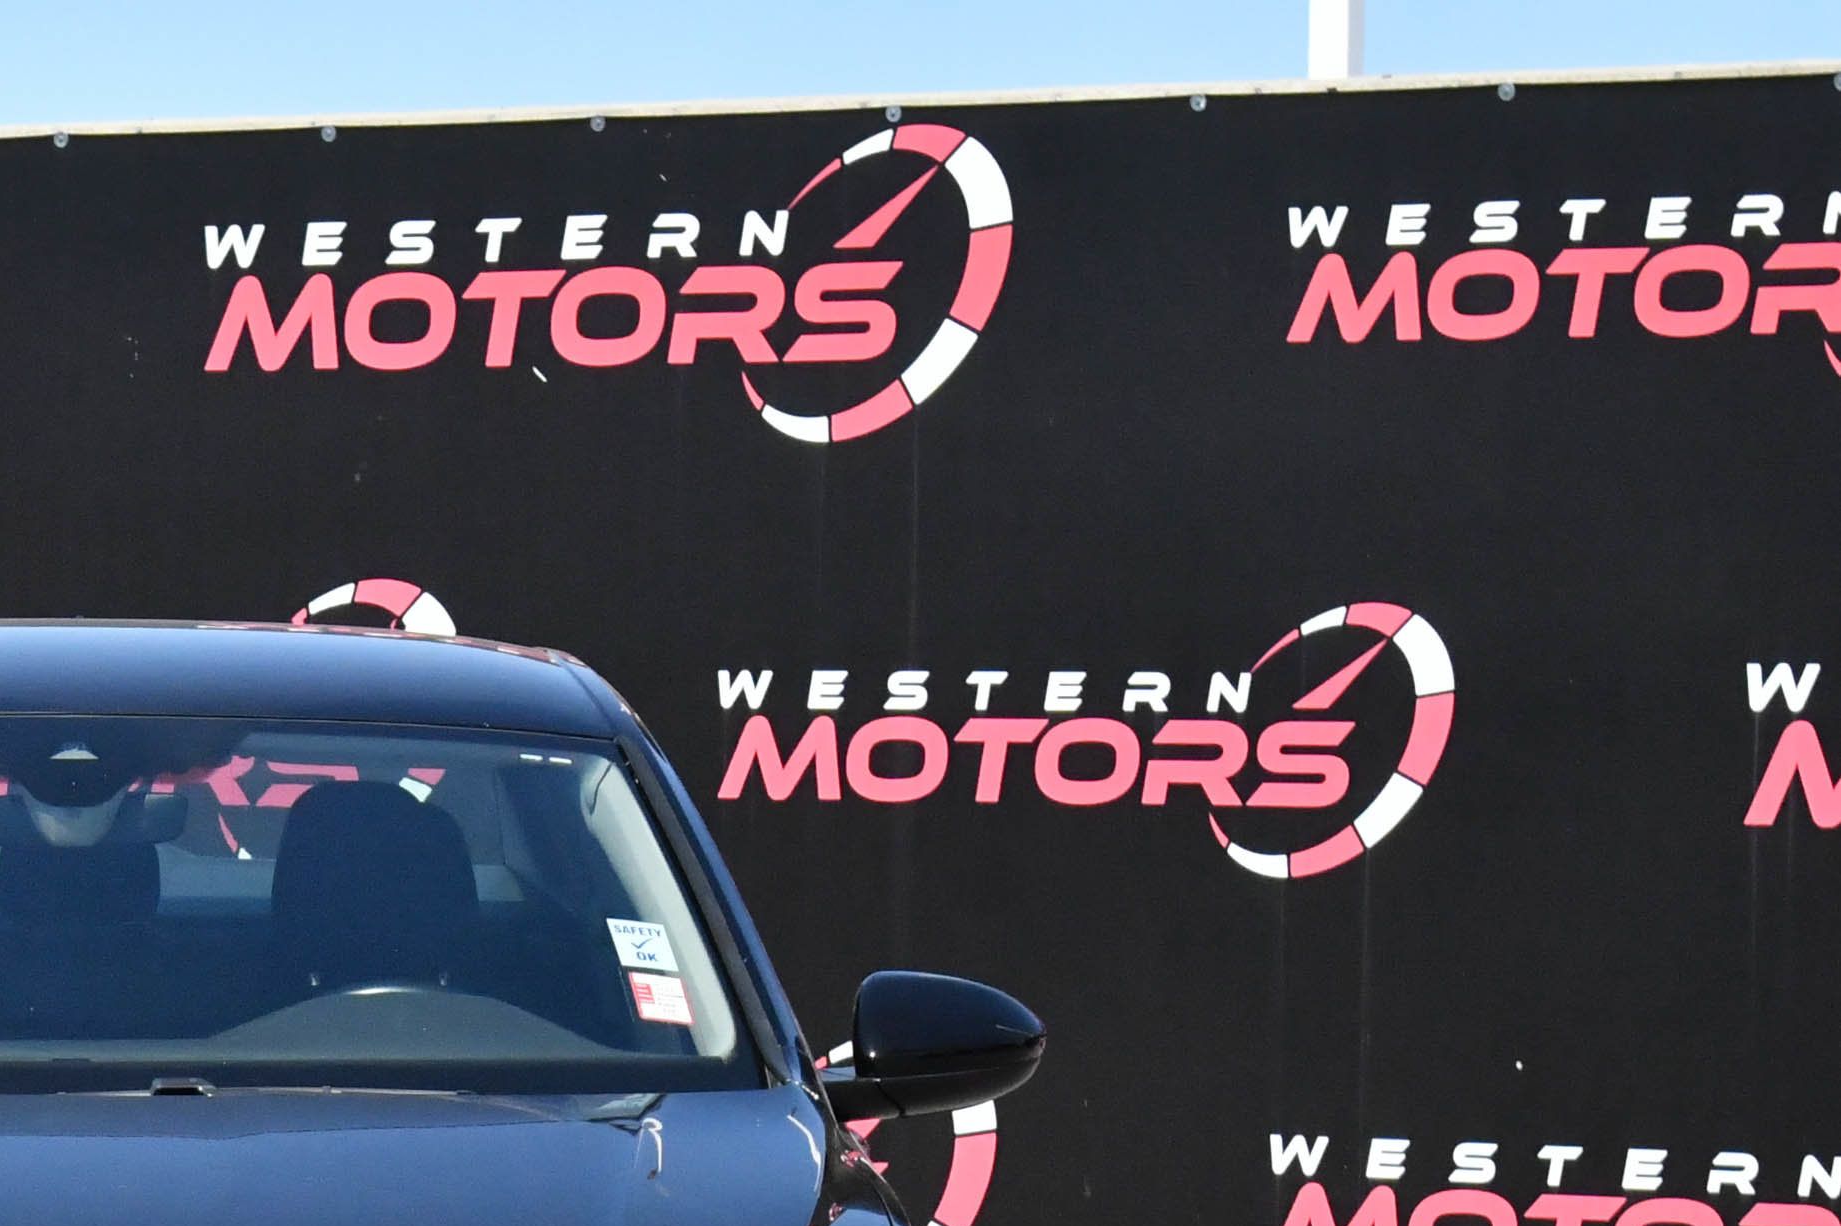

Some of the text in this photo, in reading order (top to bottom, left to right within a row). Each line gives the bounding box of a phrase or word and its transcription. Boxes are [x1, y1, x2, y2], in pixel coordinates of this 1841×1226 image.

[205, 210, 789, 269] WESTERN
[205, 261, 903, 372] MOTORS
[717, 669, 1252, 713] WESTERN
[717, 715, 1355, 808] MOTORS
[614, 924, 661, 937] SAFETY
[636, 951, 658, 962] OK
[1269, 1134, 1841, 1200] WESTERN
